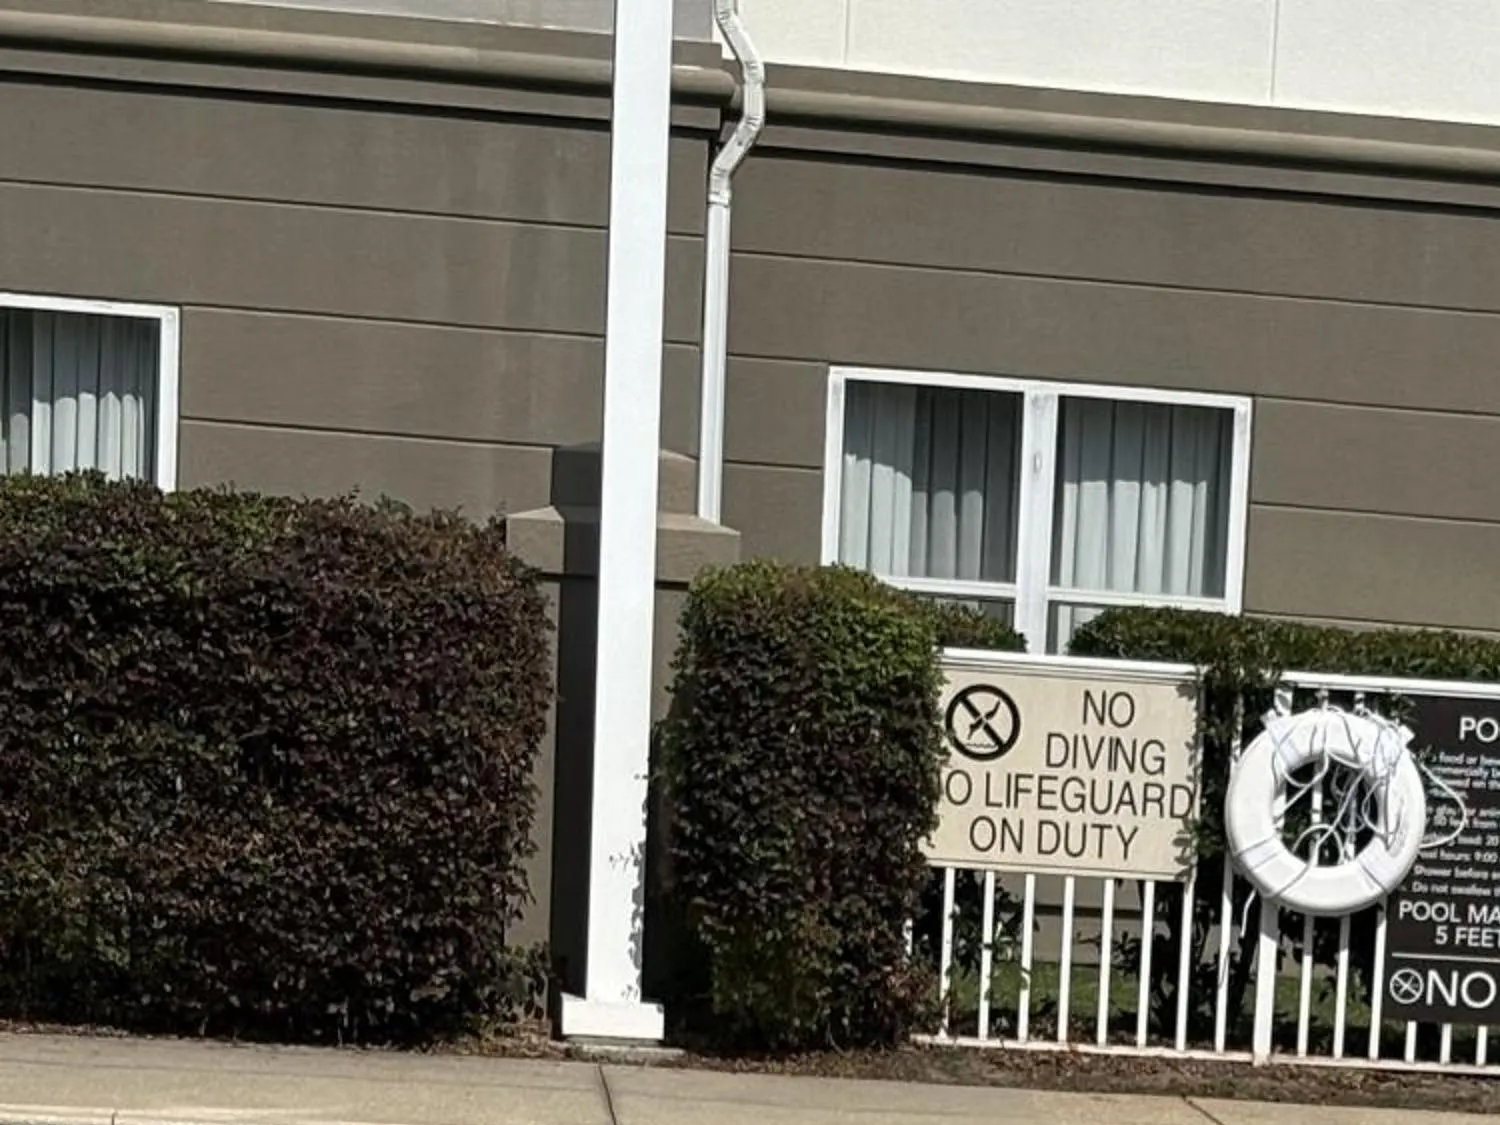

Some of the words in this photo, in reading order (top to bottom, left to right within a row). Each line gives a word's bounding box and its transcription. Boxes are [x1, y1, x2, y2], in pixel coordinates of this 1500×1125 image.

[1082, 689, 1136, 728] NO
[1046, 733, 1166, 775] DIVING
[940, 768, 973, 806] O
[985, 772, 1195, 820] LIFEGUARD
[969, 815, 1024, 853] ON
[1037, 819, 1139, 860] DUTY
[1485, 835, 1500, 847] 20
[1412, 881, 1428, 892] Do
[1399, 900, 1460, 924] POOL
[1434, 925, 1448, 945] 5
[1425, 969, 1497, 1009] NO
